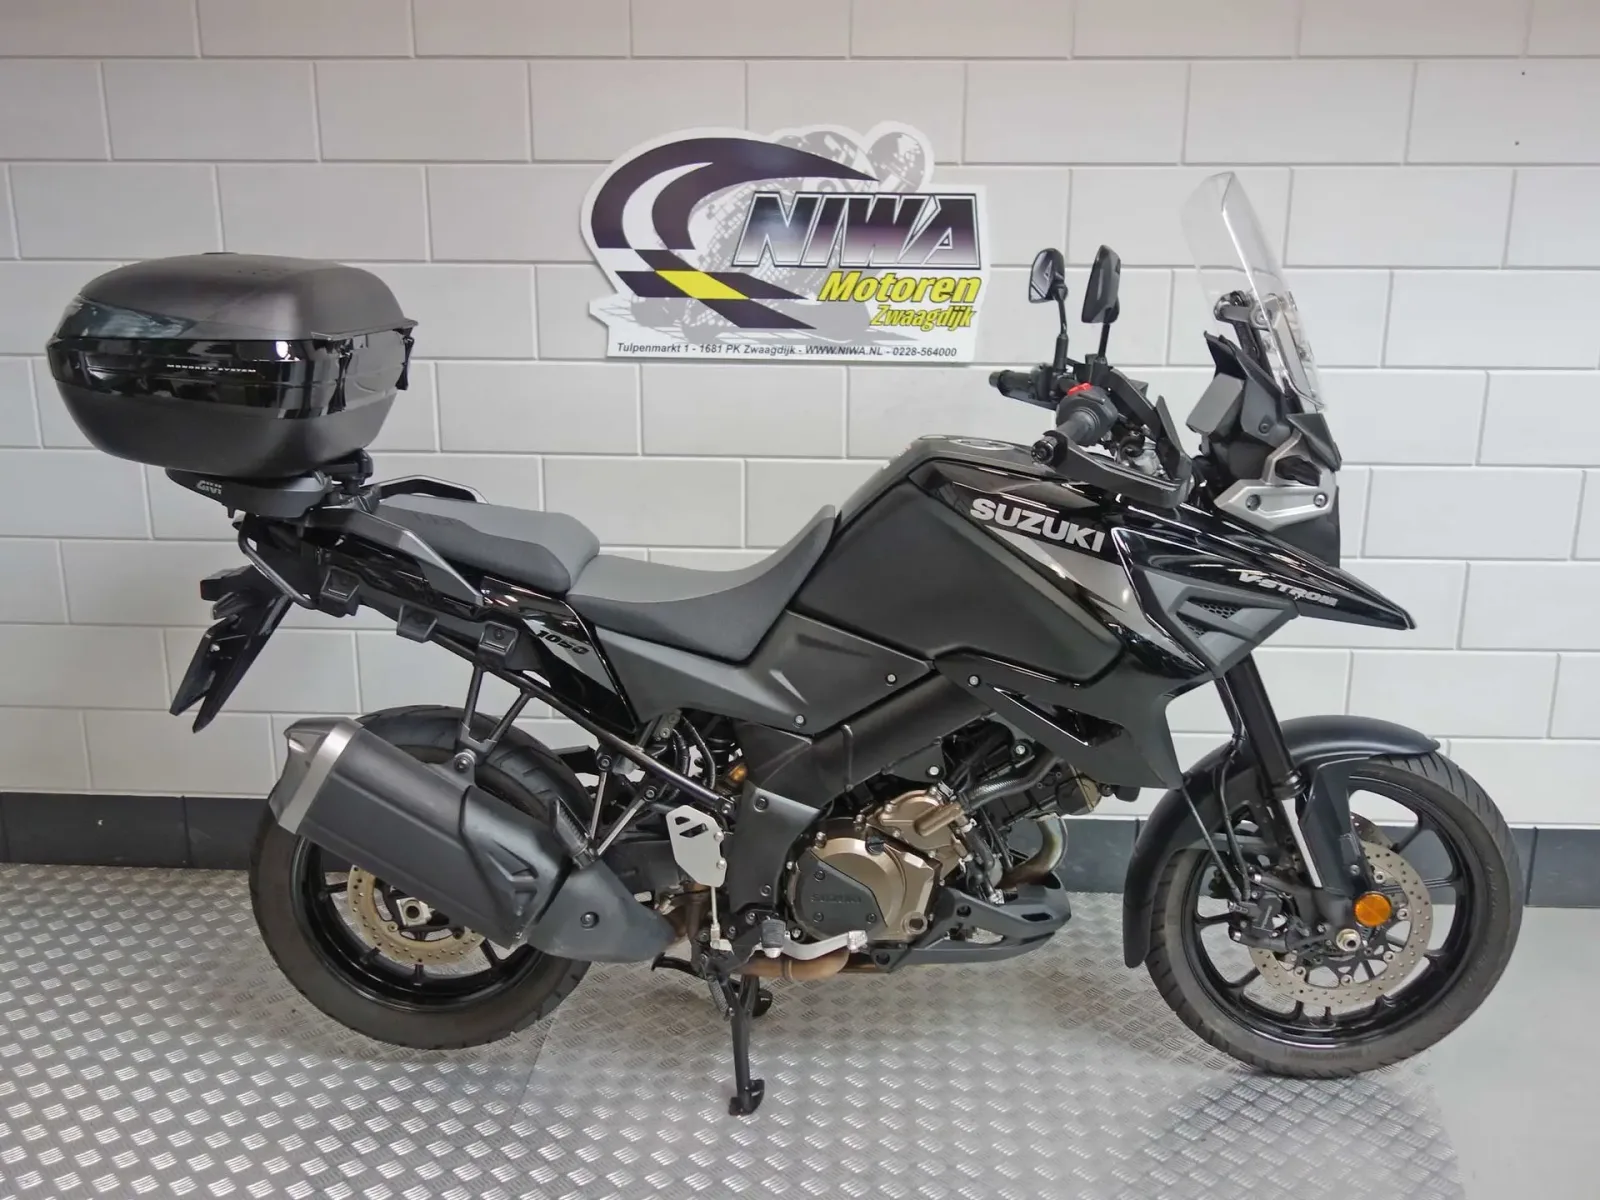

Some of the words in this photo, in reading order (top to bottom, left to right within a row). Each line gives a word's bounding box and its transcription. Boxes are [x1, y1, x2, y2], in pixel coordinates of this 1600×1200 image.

[732, 192, 981, 269] NIWA
[818, 271, 982, 303] Motoren
[870, 304, 976, 331] Zwaagdijk
[617, 342, 681, 353] Tulpenmarkt
[684, 344, 689, 353] 1
[700, 344, 722, 354] 1681
[725, 344, 741, 354] PK
[744, 344, 796, 356] Zwaagdijk
[805, 344, 884, 356] WWW.NIWA.NL
[892, 346, 957, 357] 0228-564000
[970, 498, 1106, 553] SUZUKI
